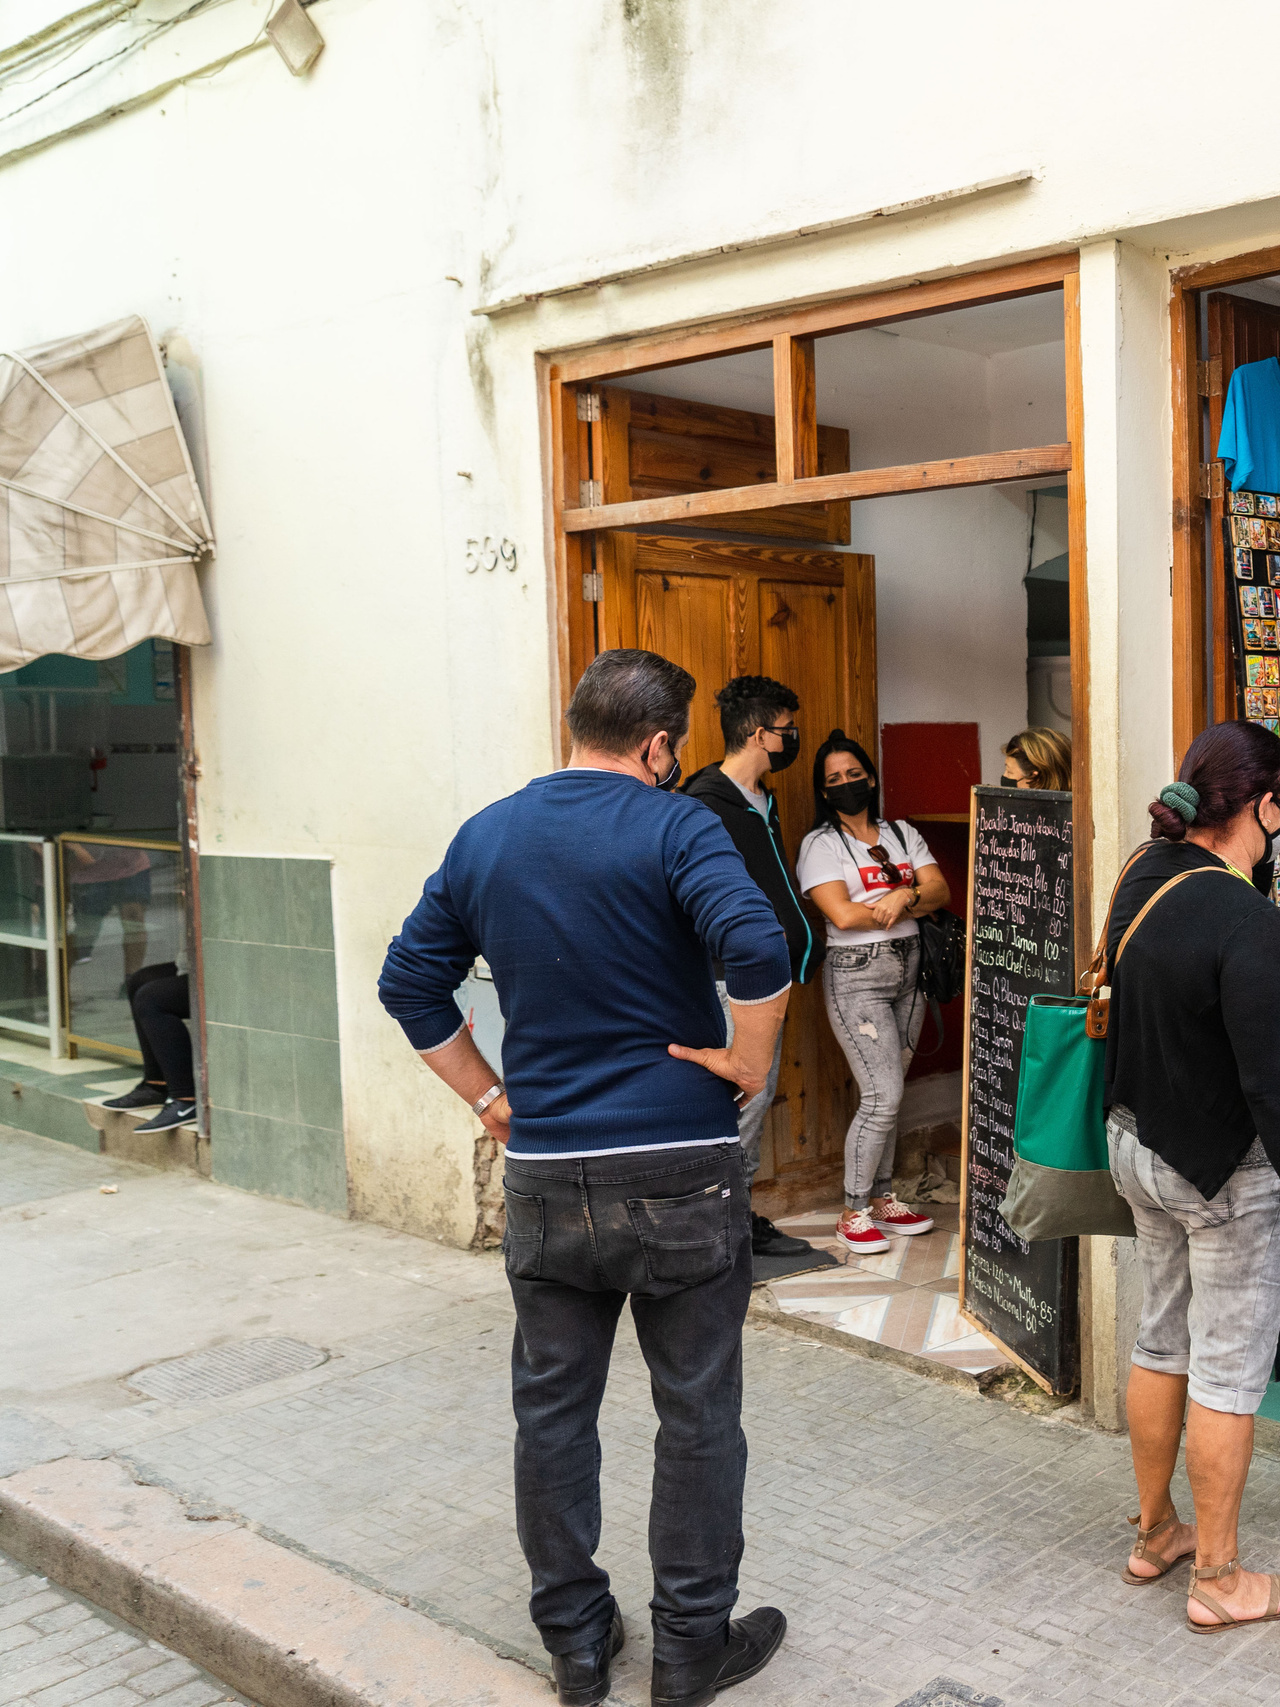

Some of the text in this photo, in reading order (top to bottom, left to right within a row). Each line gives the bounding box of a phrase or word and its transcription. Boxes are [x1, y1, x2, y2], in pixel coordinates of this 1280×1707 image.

[979, 832, 989, 855] Pan
[1020, 838, 1037, 862] Pollo
[978, 856, 988, 878] Pan
[1034, 864, 1048, 893] Pollo
[975, 917, 1003, 942] Lasaña
[1011, 925, 1038, 955] Jamón
[1006, 949, 1024, 975] Chef
[973, 967, 991, 996] Pizza
[1001, 976, 1028, 1007] Blanco
